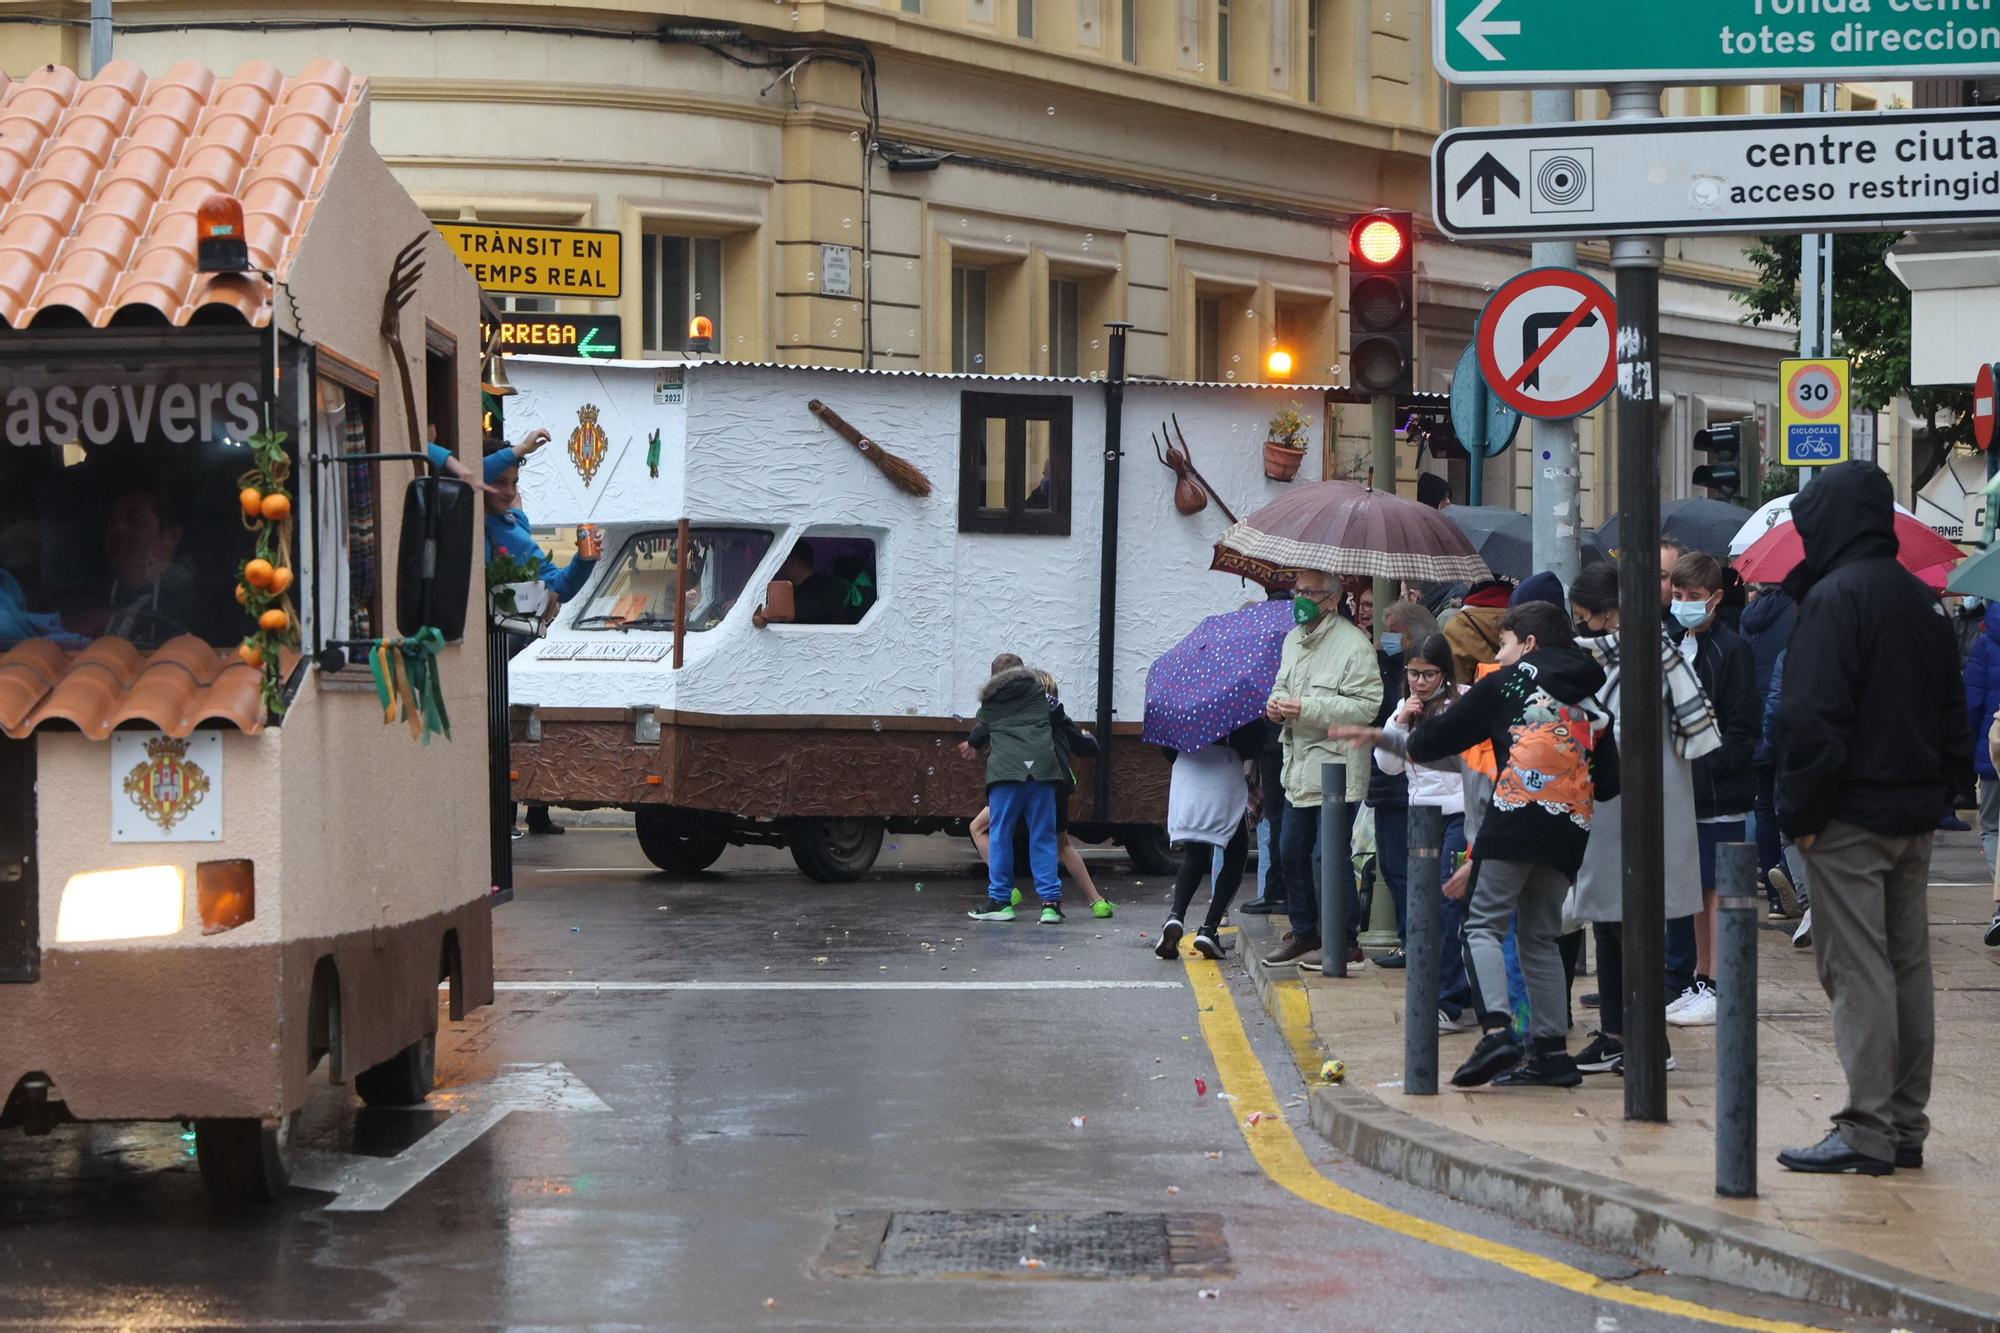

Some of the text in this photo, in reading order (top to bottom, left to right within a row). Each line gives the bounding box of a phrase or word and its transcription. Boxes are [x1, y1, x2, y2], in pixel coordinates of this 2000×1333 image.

[1719, 20, 2000, 54] totes direccion
[1745, 129, 1998, 167] centre ciuta
[1730, 170, 2000, 204] acceso restringid
[460, 231, 602, 258] TRÀNSIT EN
[548, 268, 606, 288] REAL
[480, 323, 577, 344] RREGA
[664, 394, 681, 402] 2022
[1800, 384, 1828, 401] 30
[5, 382, 260, 447] asovers
